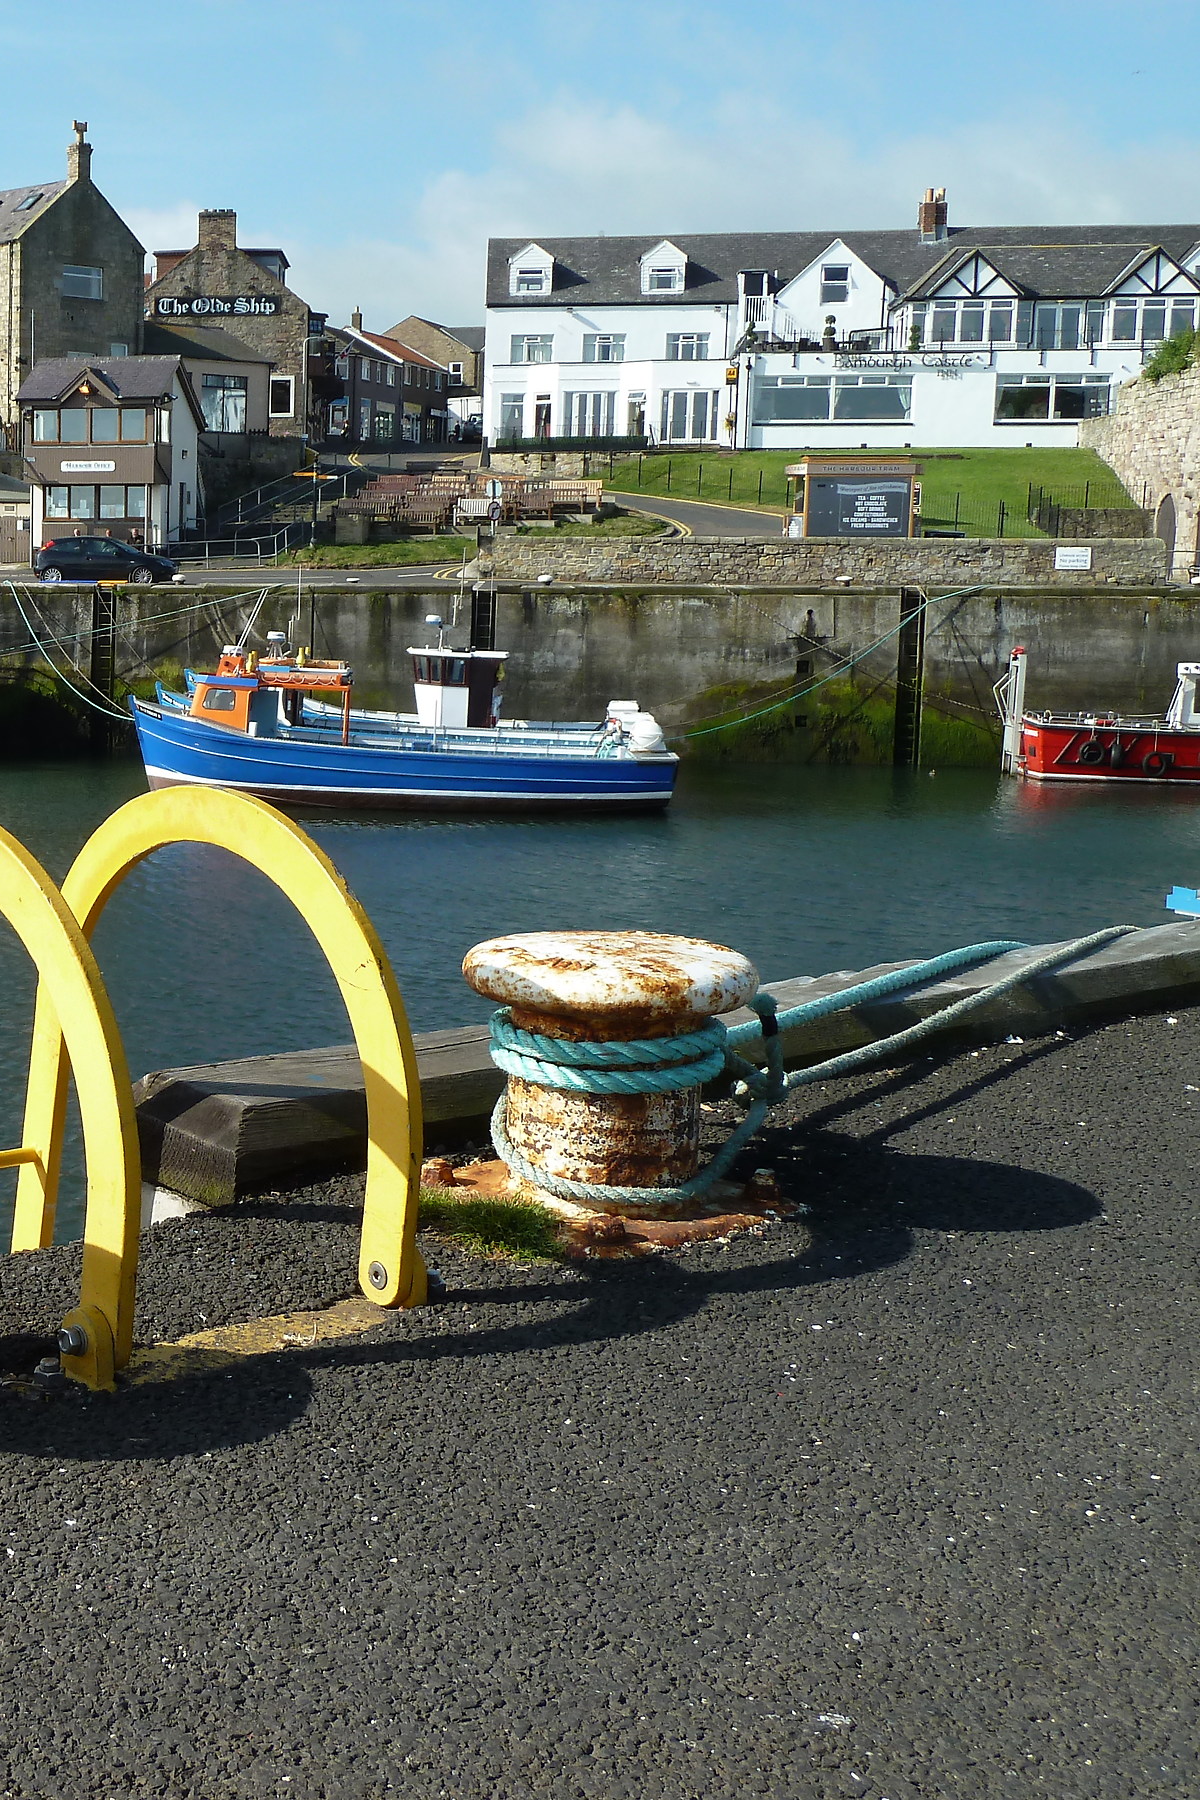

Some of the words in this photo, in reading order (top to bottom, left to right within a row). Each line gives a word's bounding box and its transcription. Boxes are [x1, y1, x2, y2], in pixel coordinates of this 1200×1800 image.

[158, 297, 189, 315] The
[191, 297, 231, 314] Olde
[233, 296, 275, 315] Ship
[832, 353, 912, 372] Bamburgh
[921, 353, 972, 368] Castle
